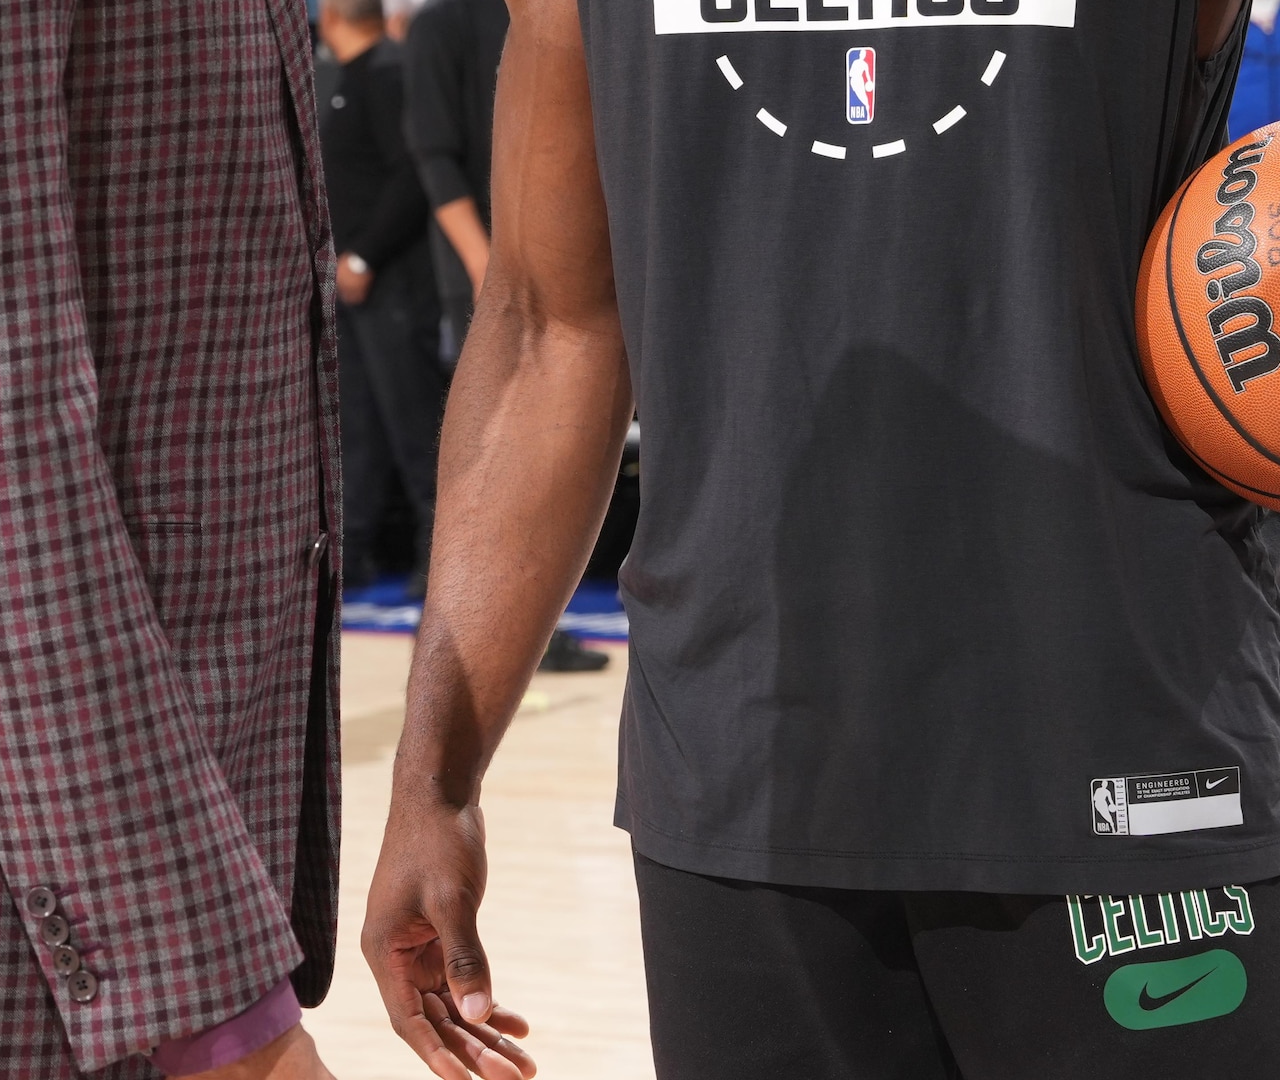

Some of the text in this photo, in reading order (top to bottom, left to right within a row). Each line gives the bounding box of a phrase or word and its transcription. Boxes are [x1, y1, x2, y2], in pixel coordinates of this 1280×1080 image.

[850, 106, 866, 119] NBA
[1135, 778, 1190, 790] ENGINEERED
[1096, 822, 1111, 833] NBA
